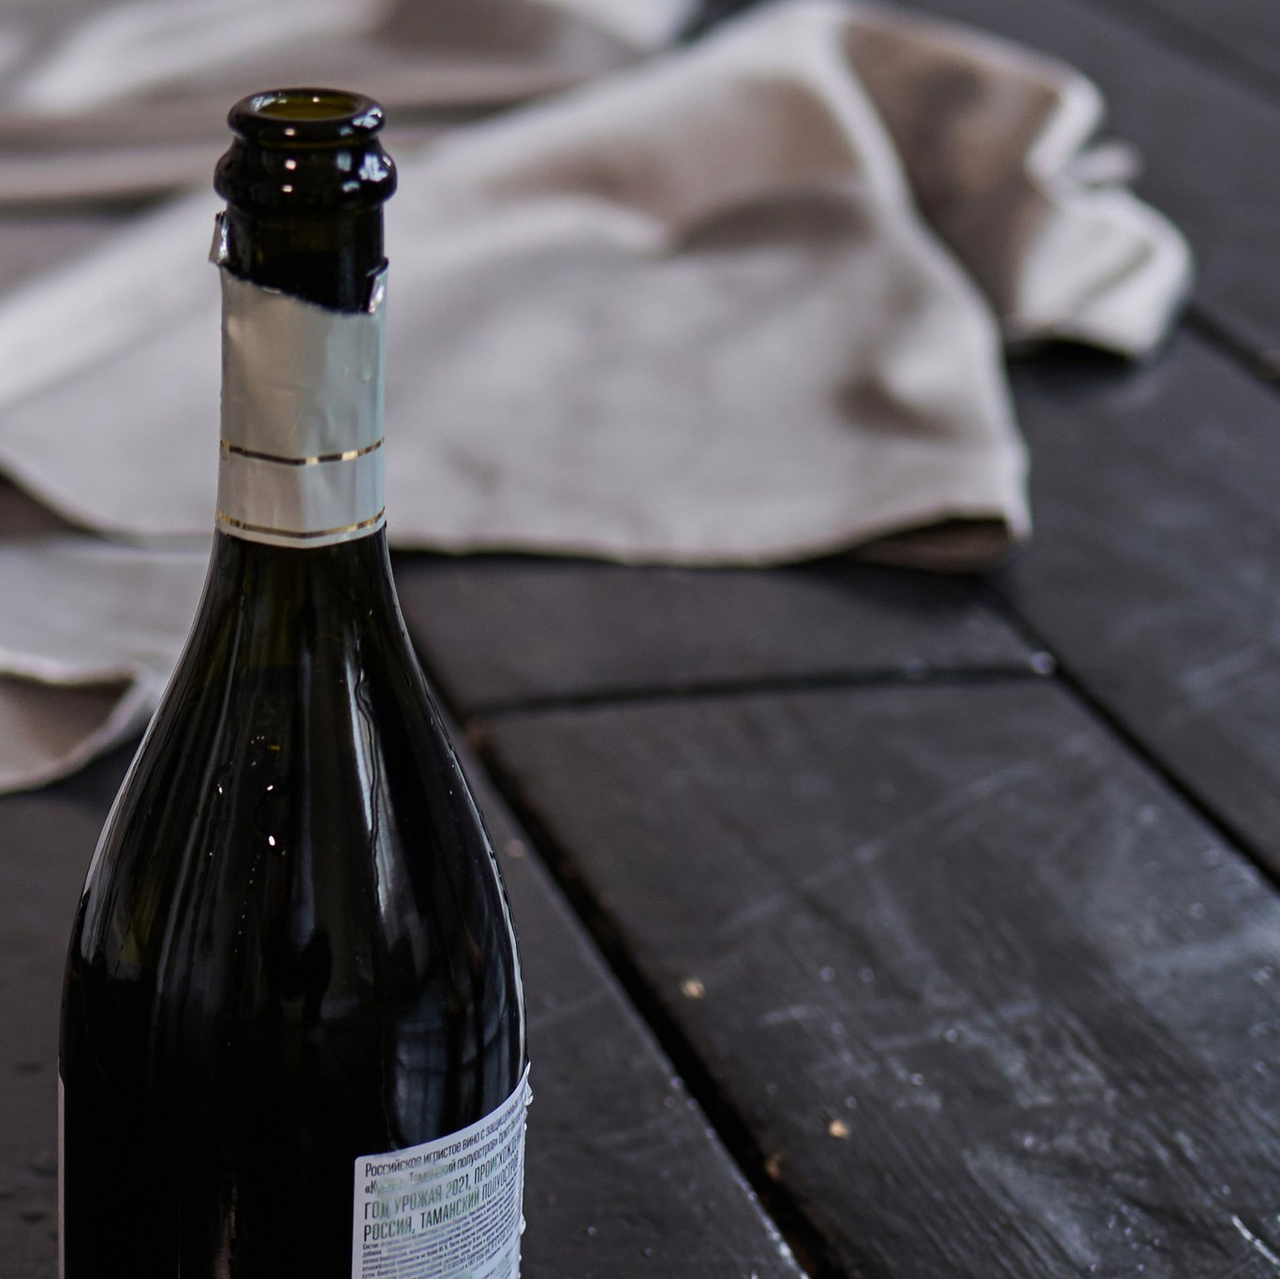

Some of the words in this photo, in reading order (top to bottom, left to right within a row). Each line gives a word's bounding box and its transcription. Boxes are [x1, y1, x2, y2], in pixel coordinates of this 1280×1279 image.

[365, 1155, 422, 1177] Российское
[423, 1141, 461, 1164] игристое
[463, 1133, 480, 1150] вино
[481, 1129, 485, 1140] с
[364, 1216, 415, 1242] РОССИЯ,
[420, 1187, 480, 1230] ТАМАНСКИЙ
[365, 1201, 389, 1220] ГОД
[395, 1184, 442, 1215] УРОЖАЯ
[446, 1173, 471, 1199] 2021,
